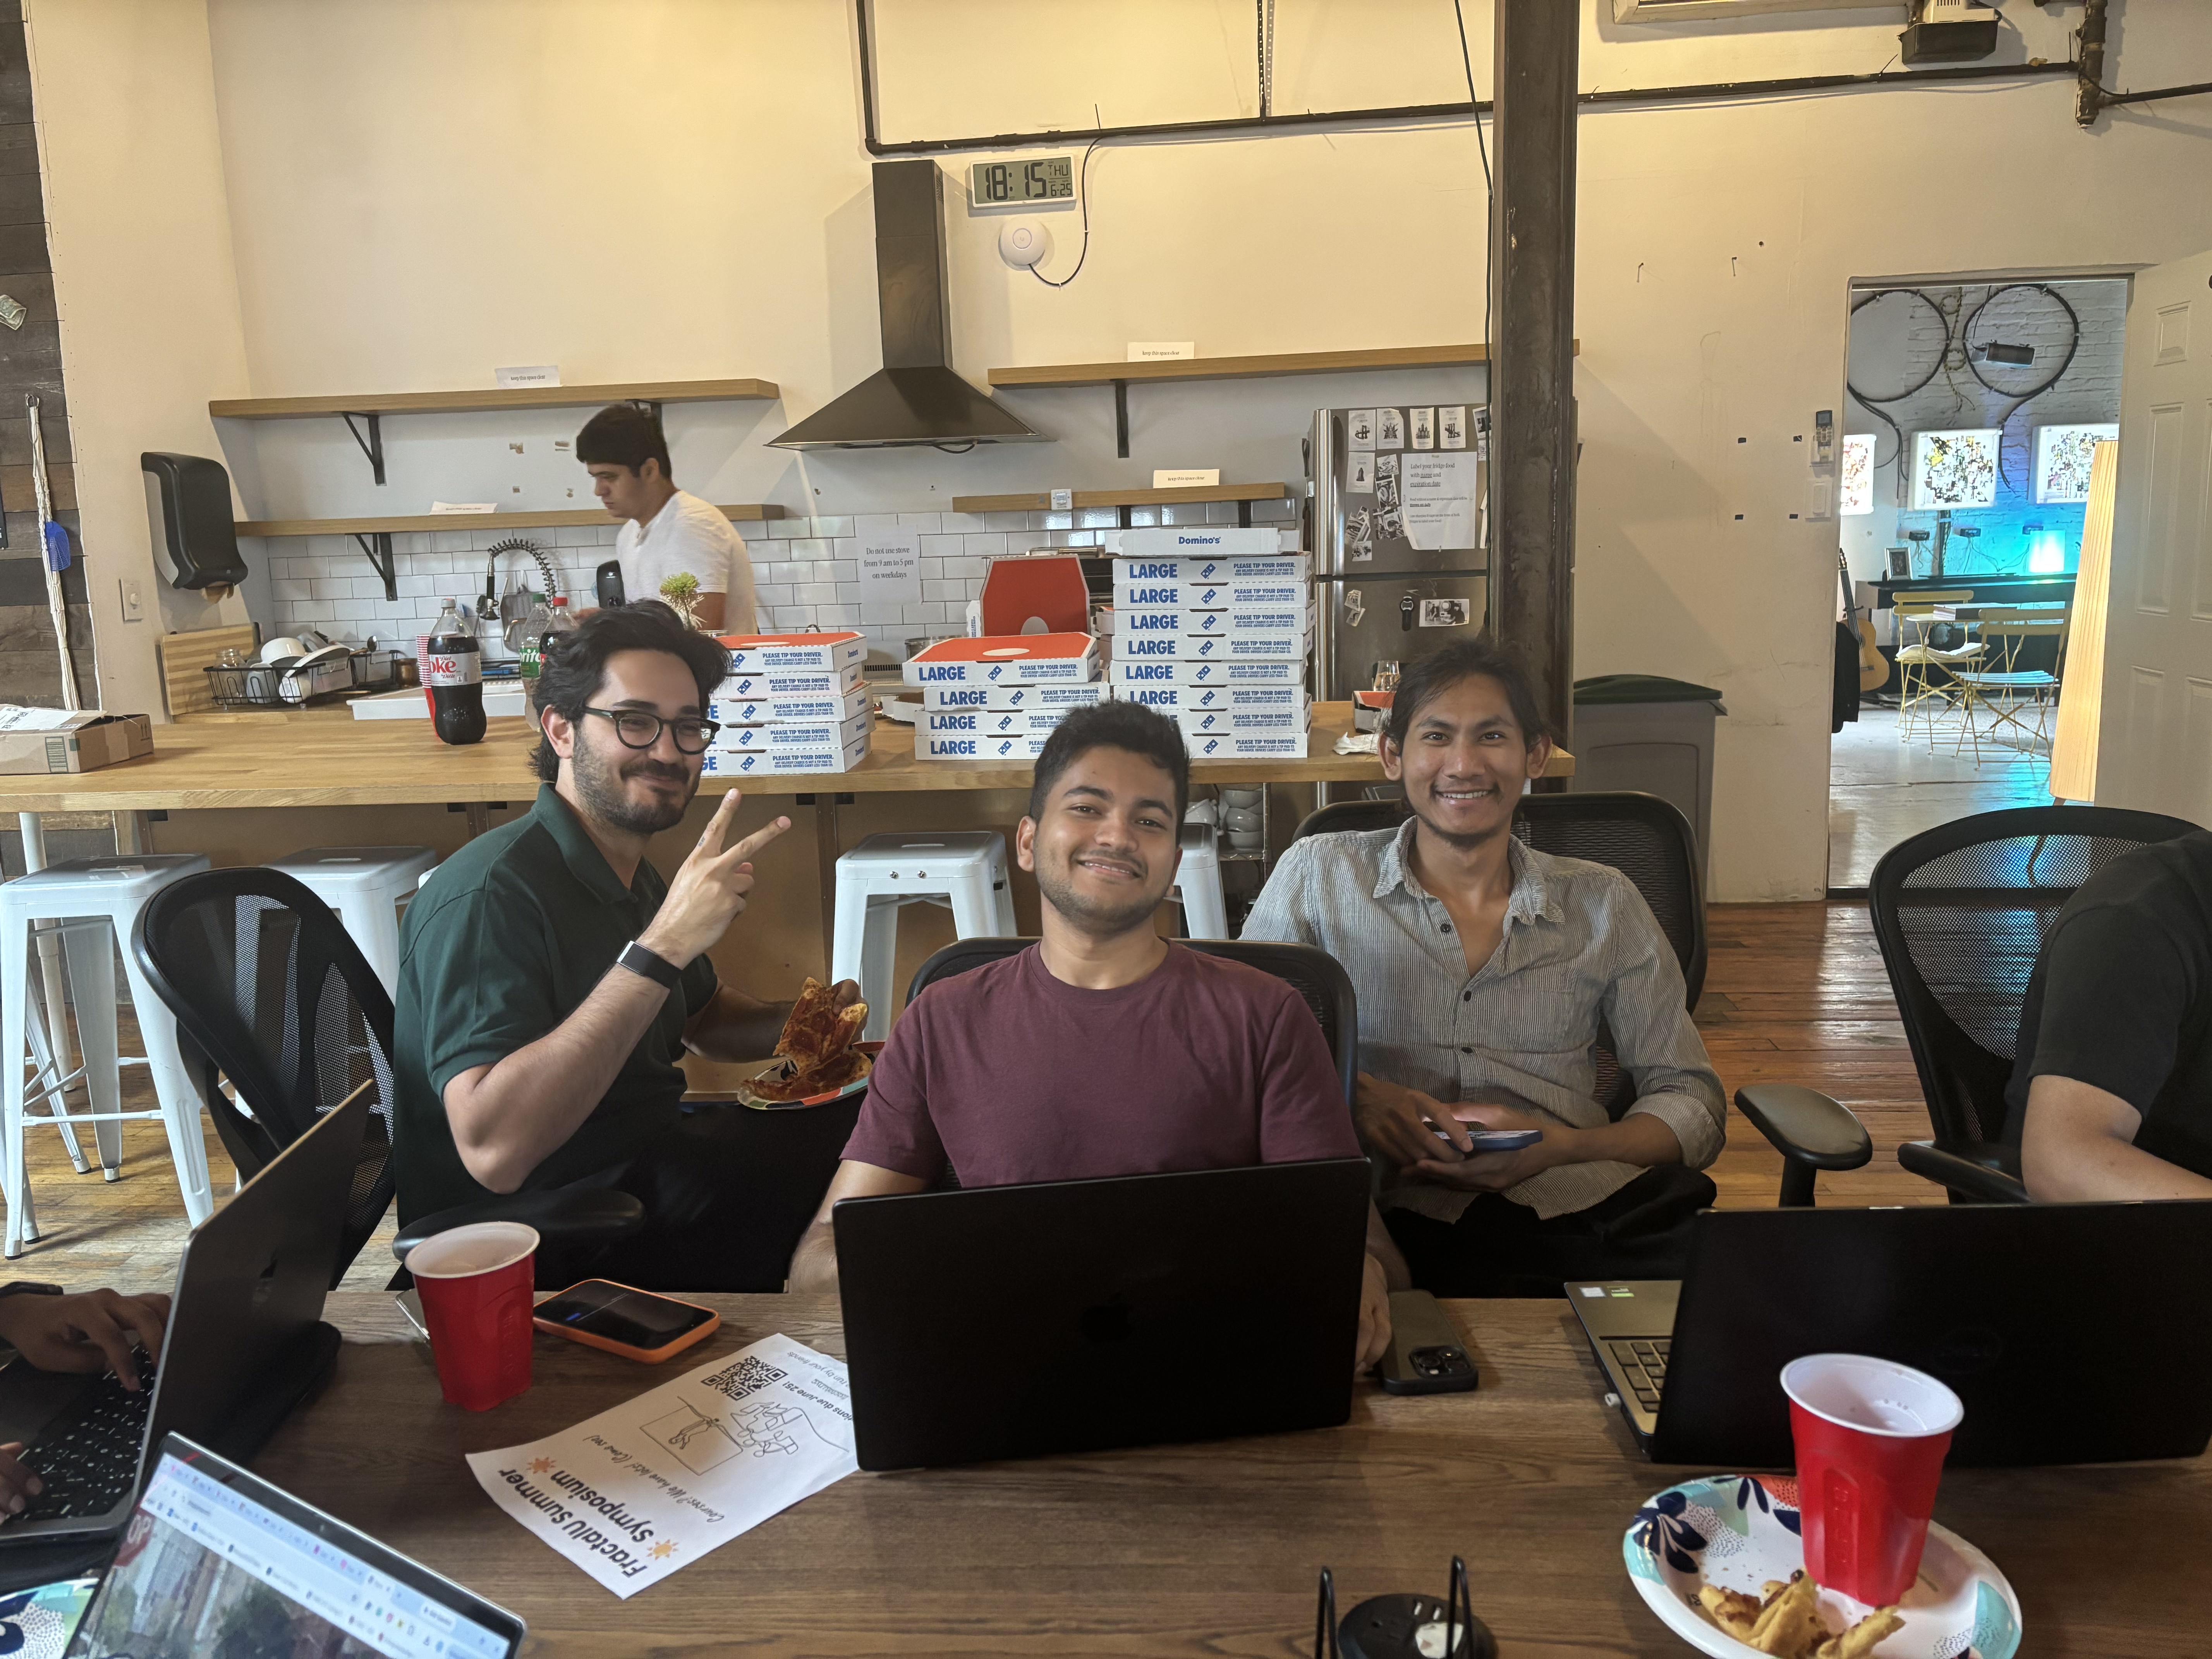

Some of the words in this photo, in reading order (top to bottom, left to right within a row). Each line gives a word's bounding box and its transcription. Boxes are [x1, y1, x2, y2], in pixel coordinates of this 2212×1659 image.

[1048, 164, 1068, 176] THU
[985, 162, 1046, 200] 18:15
[1051, 183, 1072, 196] 6-25
[1178, 536, 1220, 544] Domino's
[881, 571, 907, 579] weekdays
[1129, 564, 1178, 579] LARGE
[1130, 589, 1178, 603] LARGE
[1131, 615, 1178, 629] LARGE
[1128, 641, 1176, 654] LARGE
[520, 649, 540, 662] rite
[429, 657, 457, 673] oke
[1126, 665, 1173, 679] LARGE
[919, 666, 965, 681] LARGE
[940, 691, 987, 706] LARGE
[1130, 690, 1177, 704] LARGE
[930, 716, 976, 730] LARGE
[930, 740, 976, 755] LARGE
[787, 1352, 810, 1364] friends
[809, 1362, 827, 1371] your
[782, 1381, 799, 1391] 25!
[833, 1376, 847, 1385] run
[797, 1389, 818, 1400] June
[817, 1399, 834, 1409] due
[604, 1446, 632, 1463] (Come
[623, 1463, 654, 1476] lots!
[649, 1474, 671, 1489] have
[498, 1469, 573, 1524] Summer
[666, 1486, 686, 1499] We
[550, 1470, 654, 1543] Symposium
[676, 1497, 724, 1523] Courses?
[127, 1514, 152, 1544] OP
[562, 1520, 647, 1578] FractalU
